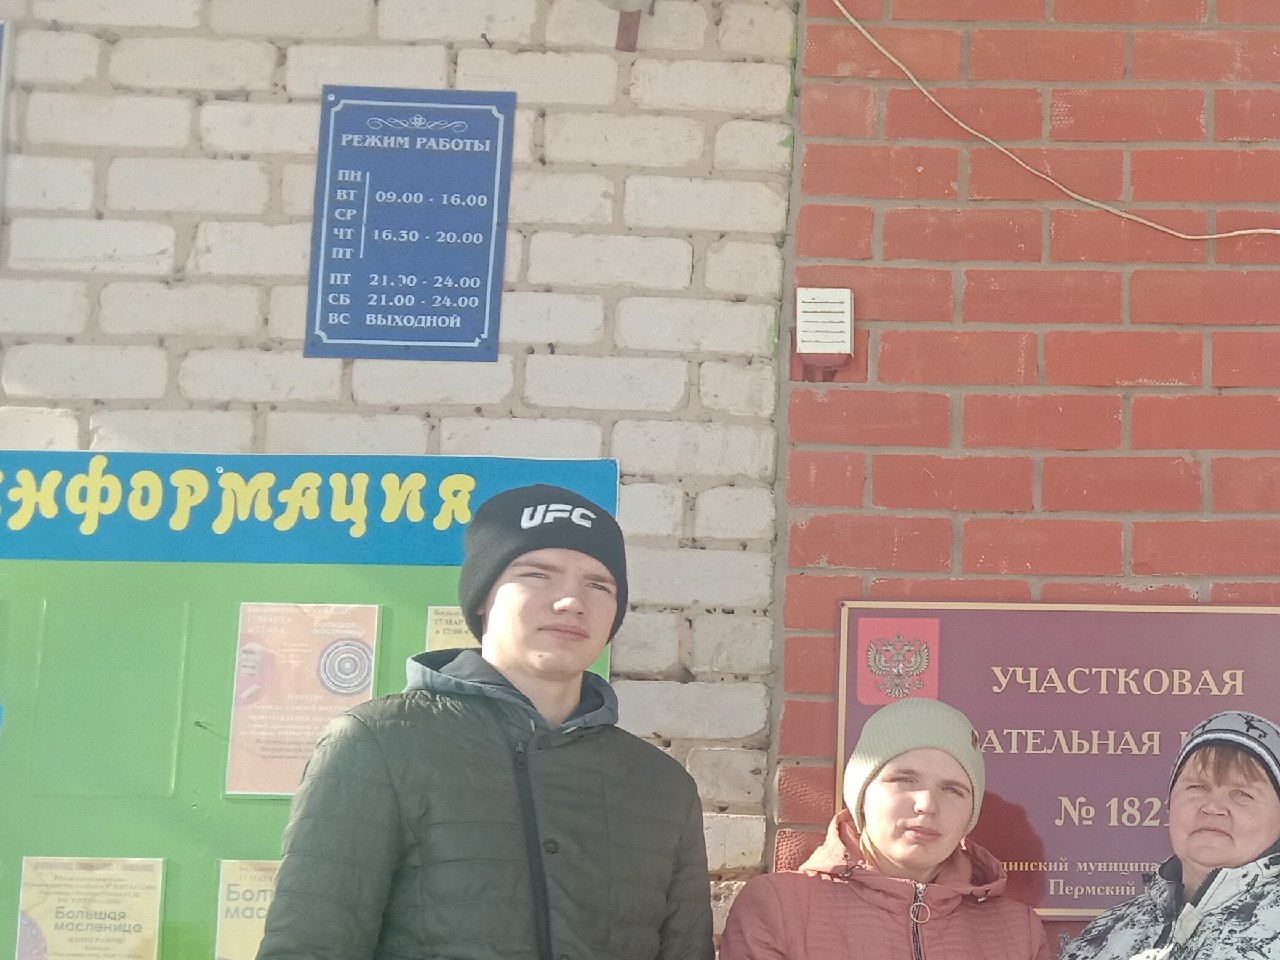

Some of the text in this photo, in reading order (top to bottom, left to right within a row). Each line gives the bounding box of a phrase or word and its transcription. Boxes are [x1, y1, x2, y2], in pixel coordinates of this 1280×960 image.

[340, 133, 491, 153] РЕЖИМ РАБОТЫ
[337, 169, 362, 182] ПН
[336, 189, 358, 201] ВТ
[374, 191, 424, 205] 09.00
[441, 193, 488, 207] 16.00
[334, 208, 357, 221] СР
[333, 228, 355, 240] ЧТ
[373, 229, 419, 242] 16.30
[435, 230, 484, 244] 20.00
[331, 247, 354, 259] ПТ
[329, 273, 352, 285] ПТ
[433, 275, 481, 289] 24.00
[327, 293, 351, 306] СБ
[367, 294, 415, 307] 21.00
[431, 295, 479, 308] 24.00
[327, 313, 461, 328] ВС ВЫХОДНОЙ
[0, 454, 475, 537] НФОРМАЦИЯ
[520, 503, 598, 529] UFC
[990, 665, 1246, 698] УЧАСТКОВАЯ
[974, 728, 1162, 755] АТЕЛЬНАЯ
[1054, 796, 1096, 827] №
[226, 883, 272, 902] Бол
[1048, 878, 1136, 899] Пермский
[54, 906, 127, 921] Большая
